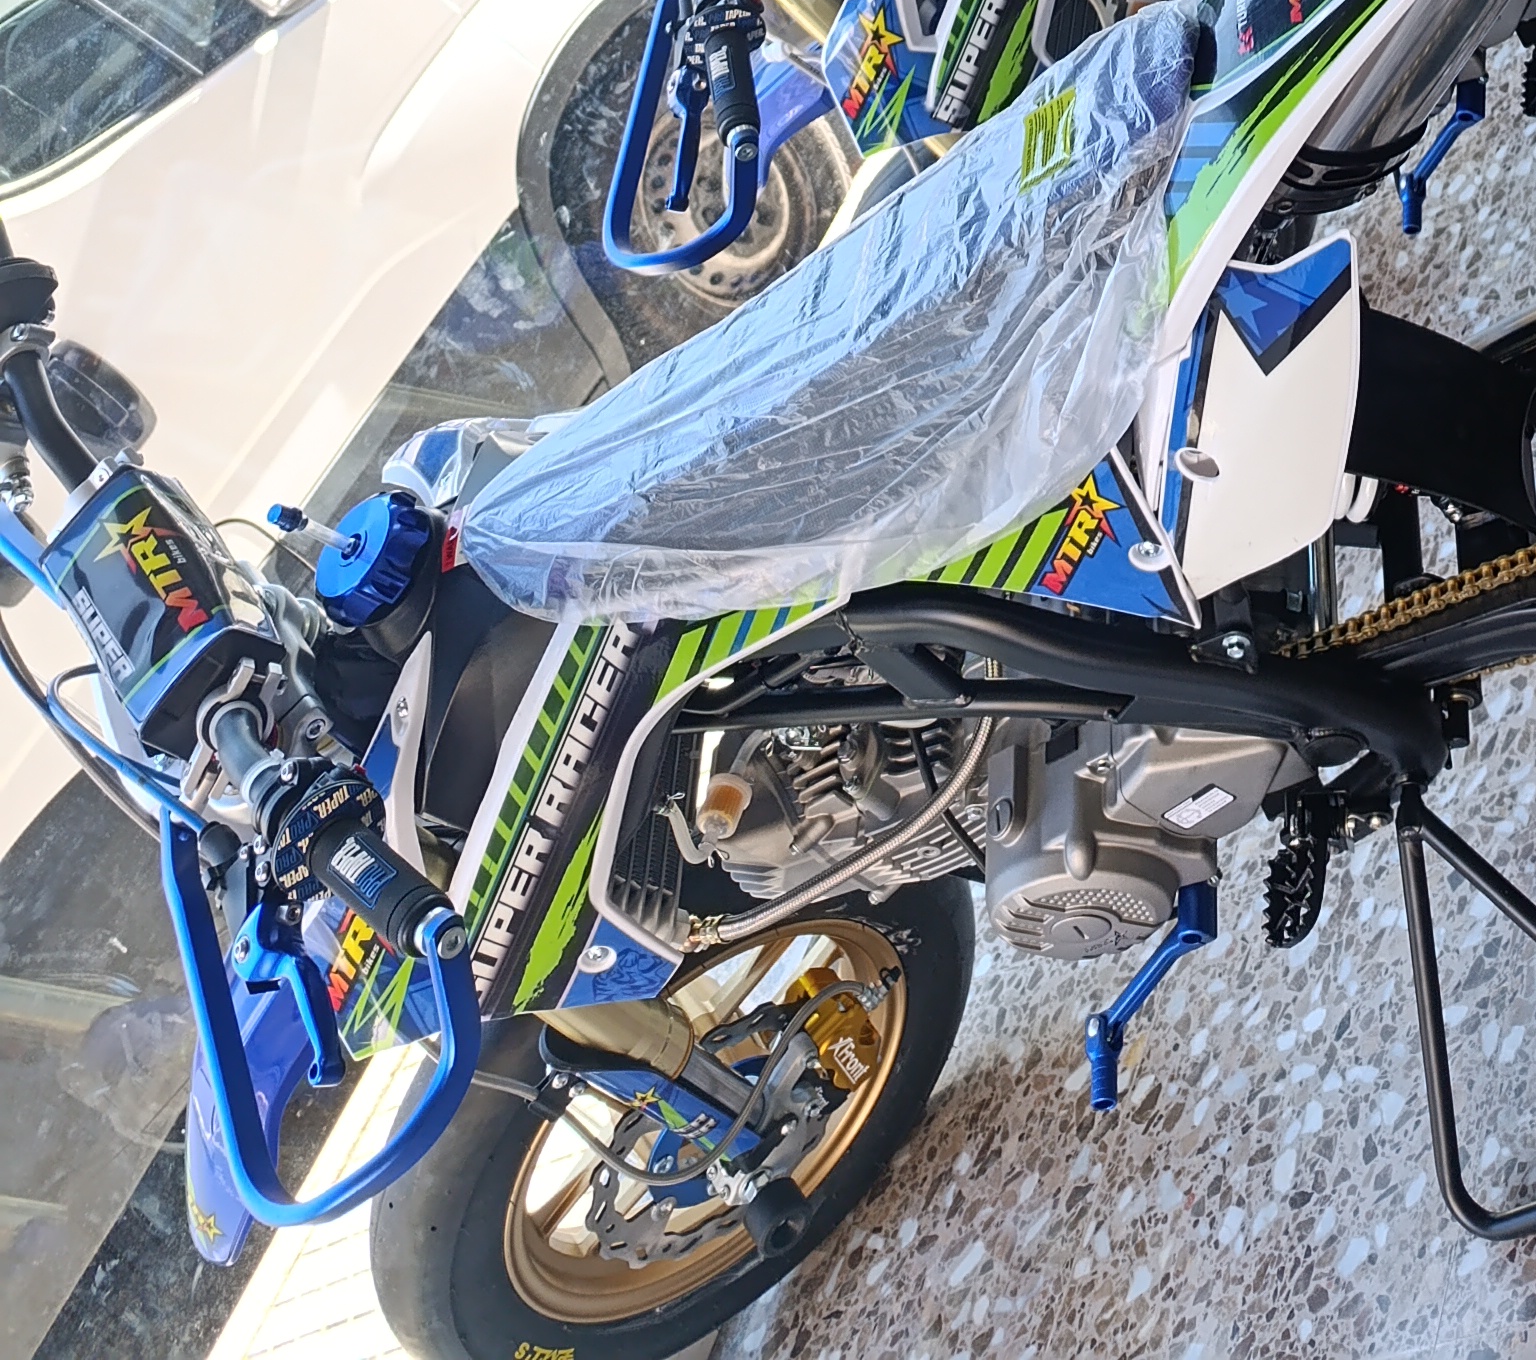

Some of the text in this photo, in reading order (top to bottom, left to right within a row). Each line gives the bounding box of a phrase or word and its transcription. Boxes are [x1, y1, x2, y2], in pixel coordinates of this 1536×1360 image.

[842, 45, 885, 119] MTR
[131, 535, 209, 632] MTR
[165, 539, 187, 564] bikes
[1041, 509, 1099, 595] MTR
[1086, 531, 1103, 555] bikes
[72, 588, 136, 681] SUPER
[536, 616, 642, 828] RACER
[328, 914, 374, 1012] MTR
[362, 943, 380, 976] bikes
